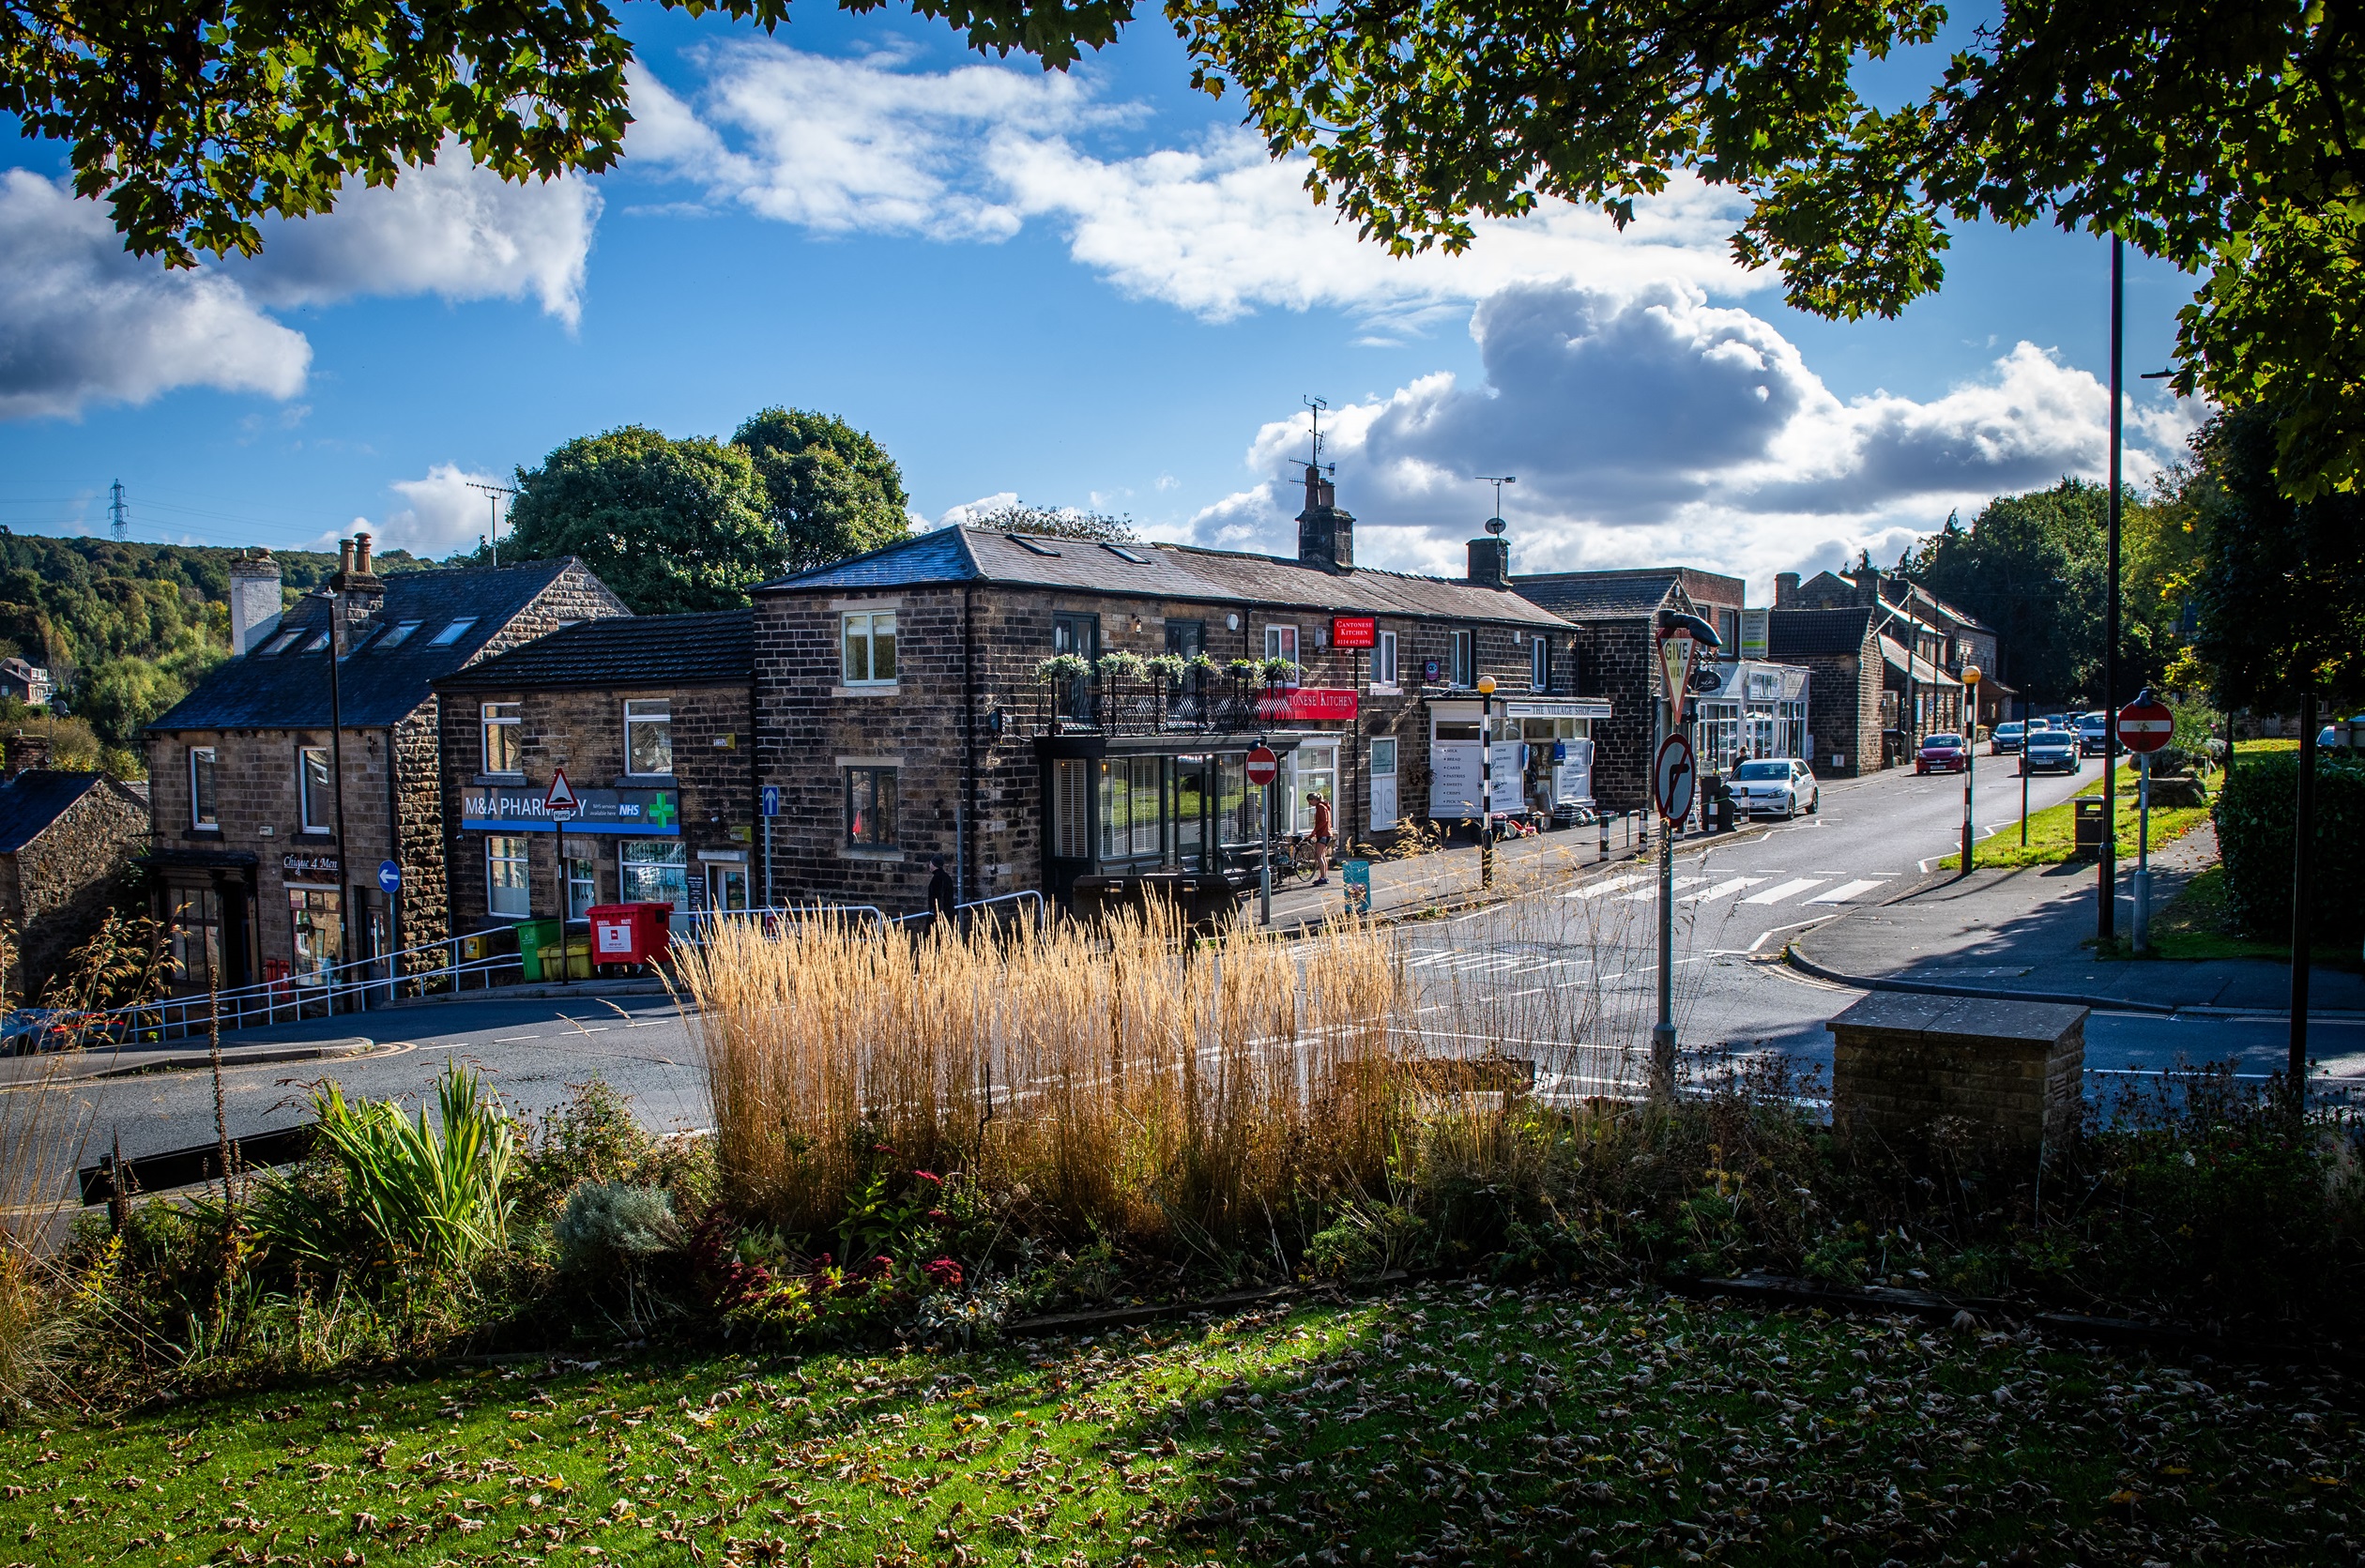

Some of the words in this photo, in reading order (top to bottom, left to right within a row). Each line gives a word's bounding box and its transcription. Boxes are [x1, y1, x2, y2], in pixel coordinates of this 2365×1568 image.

[1665, 643, 1688, 661] GIVE
[1670, 666, 1685, 678] WAY
[1320, 692, 1353, 707] KITCHEN
[1532, 706, 1544, 715] THE
[1547, 706, 1573, 715] VILLAGE
[1575, 707, 1590, 716] SHOP
[465, 797, 497, 815] M&A
[500, 798, 587, 817] PHARMY
[619, 804, 640, 815] NHS
[311, 858, 318, 870] 4
[320, 858, 338, 868] Men
